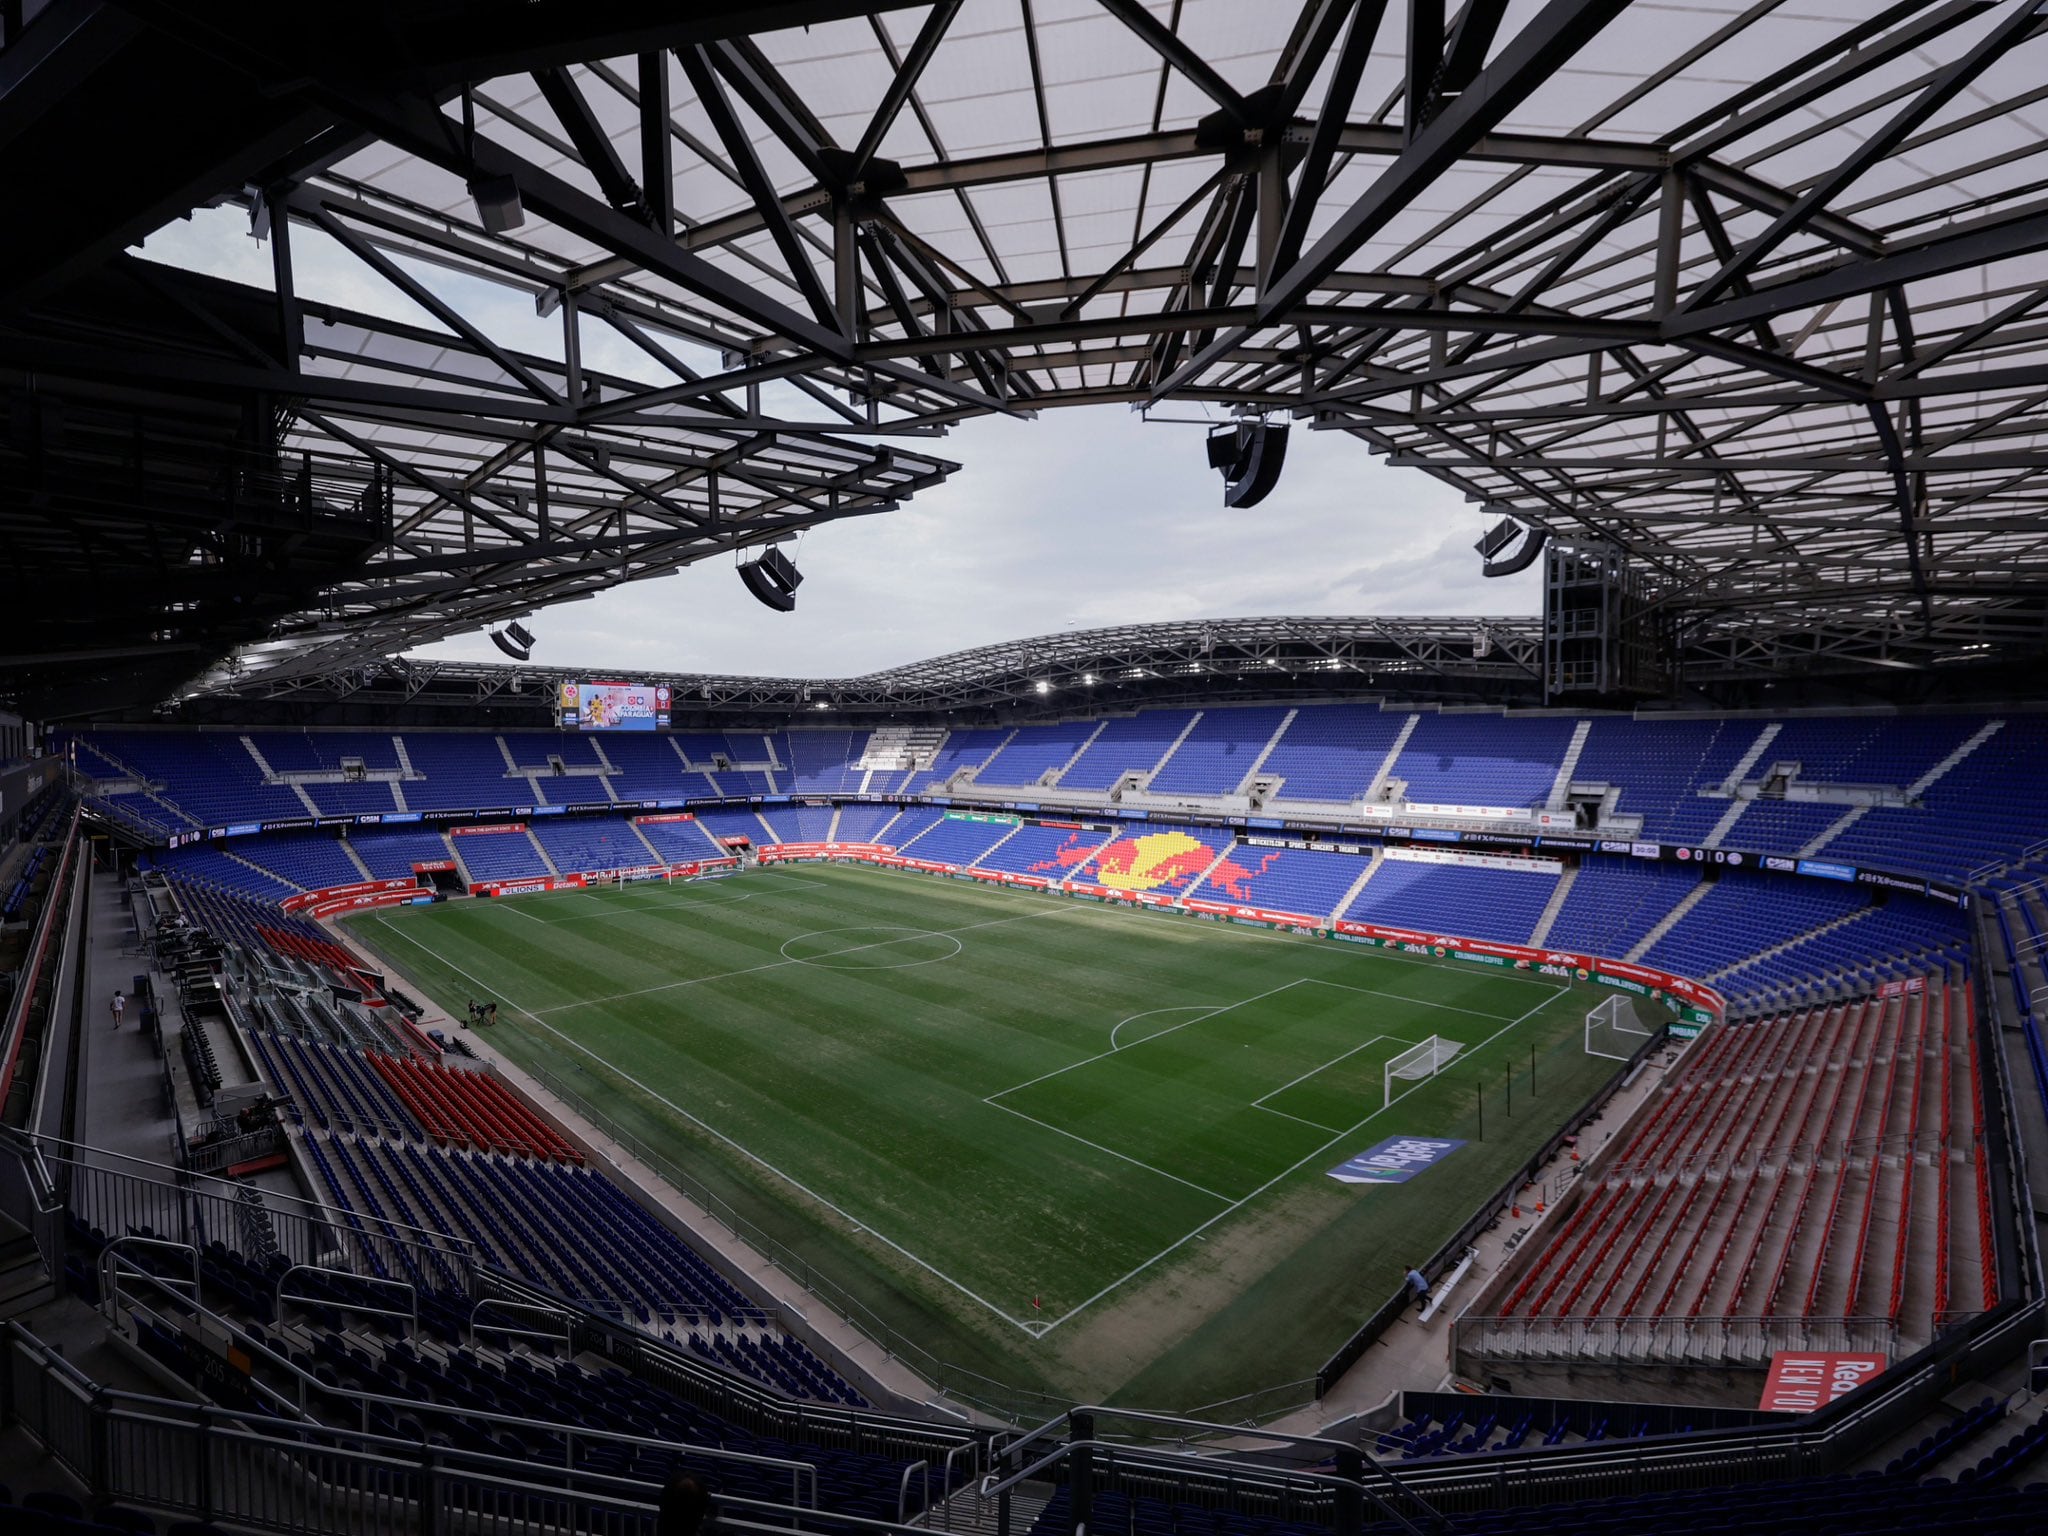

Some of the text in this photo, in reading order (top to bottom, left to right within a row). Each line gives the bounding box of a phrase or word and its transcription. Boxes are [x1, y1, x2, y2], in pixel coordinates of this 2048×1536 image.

[1694, 849, 1703, 860] 0
[1715, 851, 1724, 863] 0
[511, 884, 539, 894] LIONS
[553, 881, 578, 889] Betano
[1484, 955, 1504, 966] COFFEE
[1354, 1139, 1451, 1169] BetPlay
[1778, 1359, 1826, 1385] NEW
